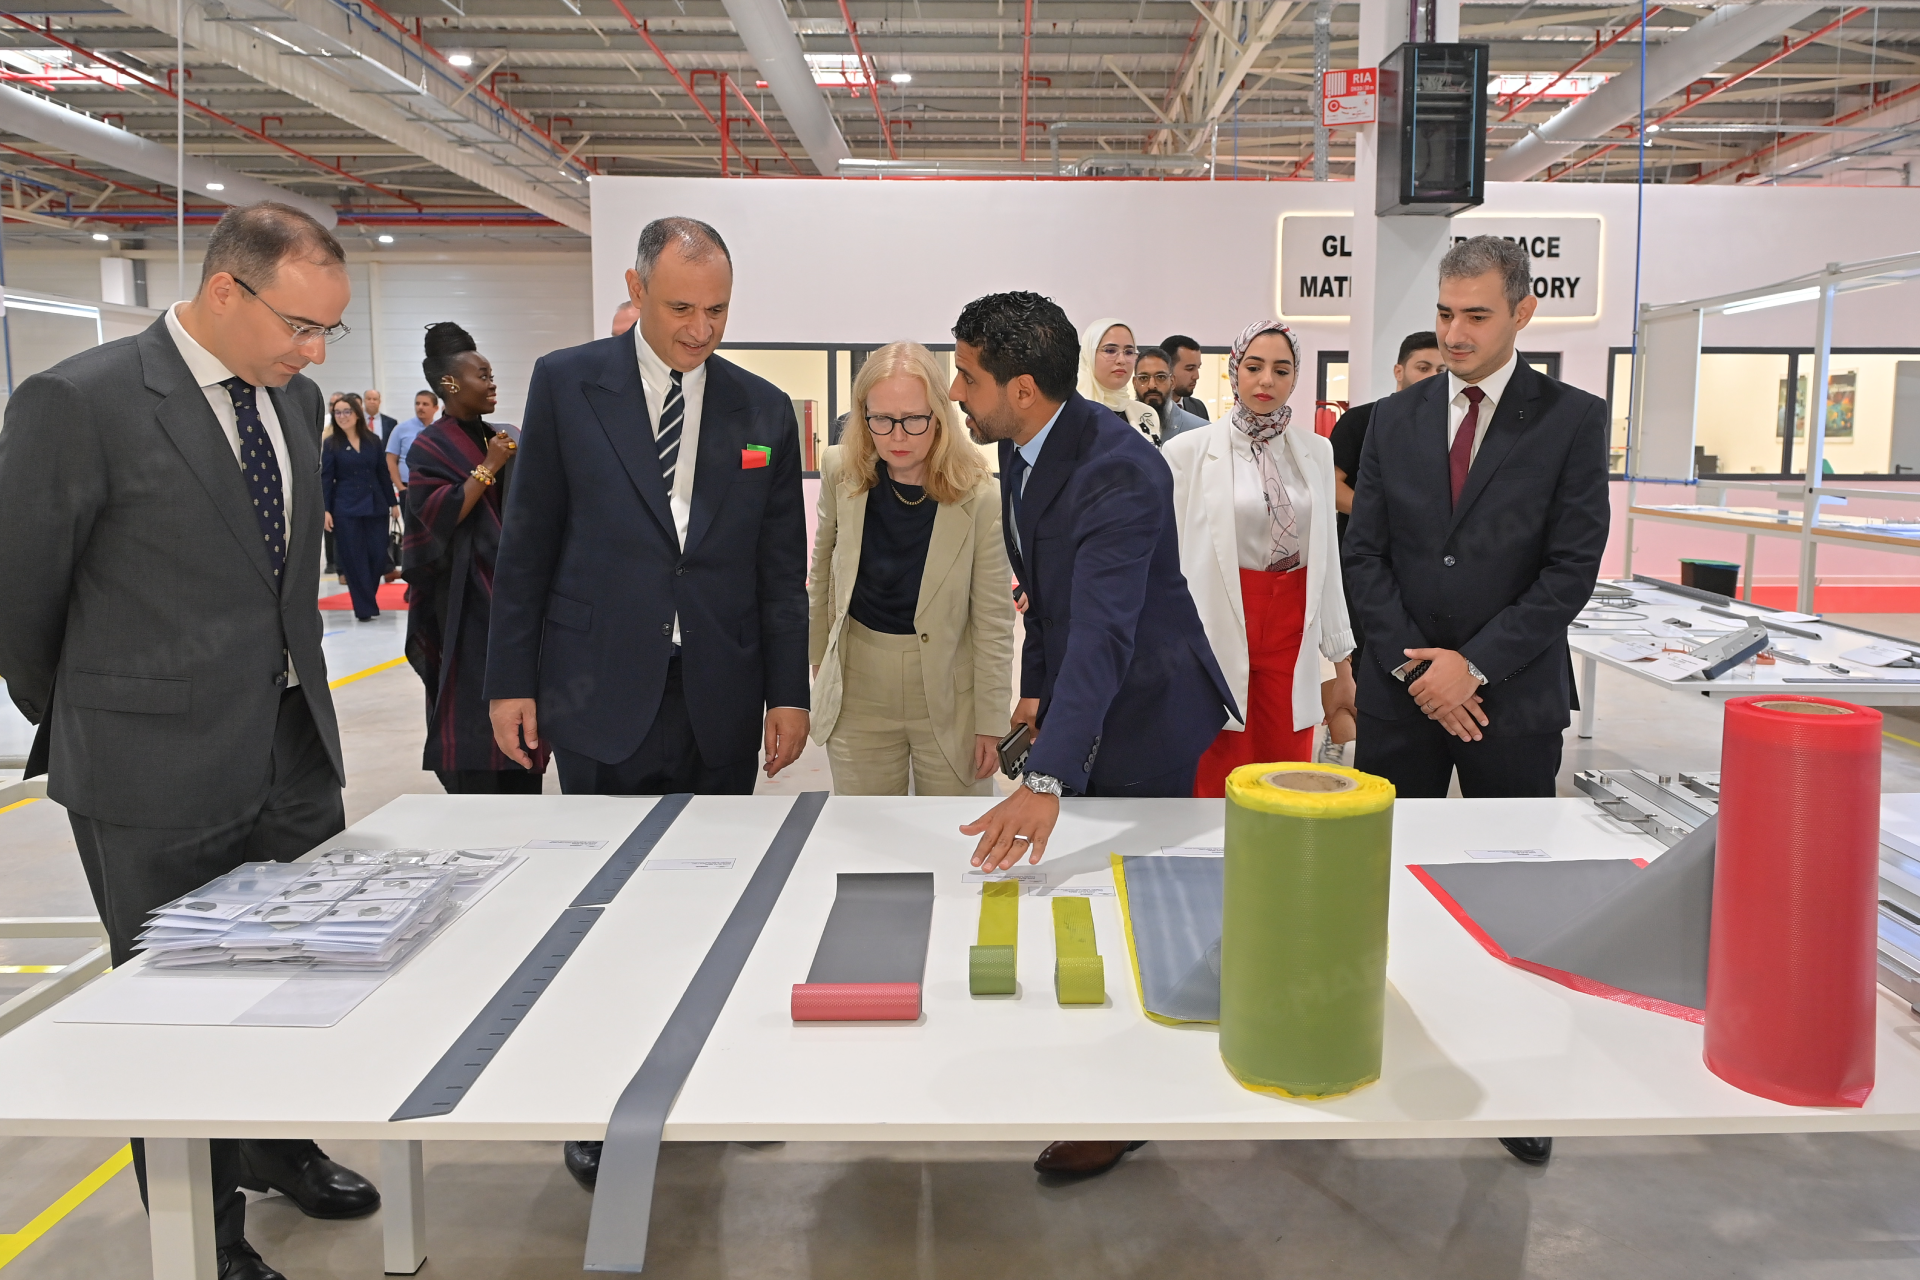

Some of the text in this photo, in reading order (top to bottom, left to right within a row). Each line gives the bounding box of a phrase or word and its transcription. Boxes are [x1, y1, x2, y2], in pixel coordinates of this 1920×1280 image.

[1352, 72, 1372, 84] RIA
[1322, 235, 1352, 257] GL
[1300, 276, 1581, 298] MAT ORY
